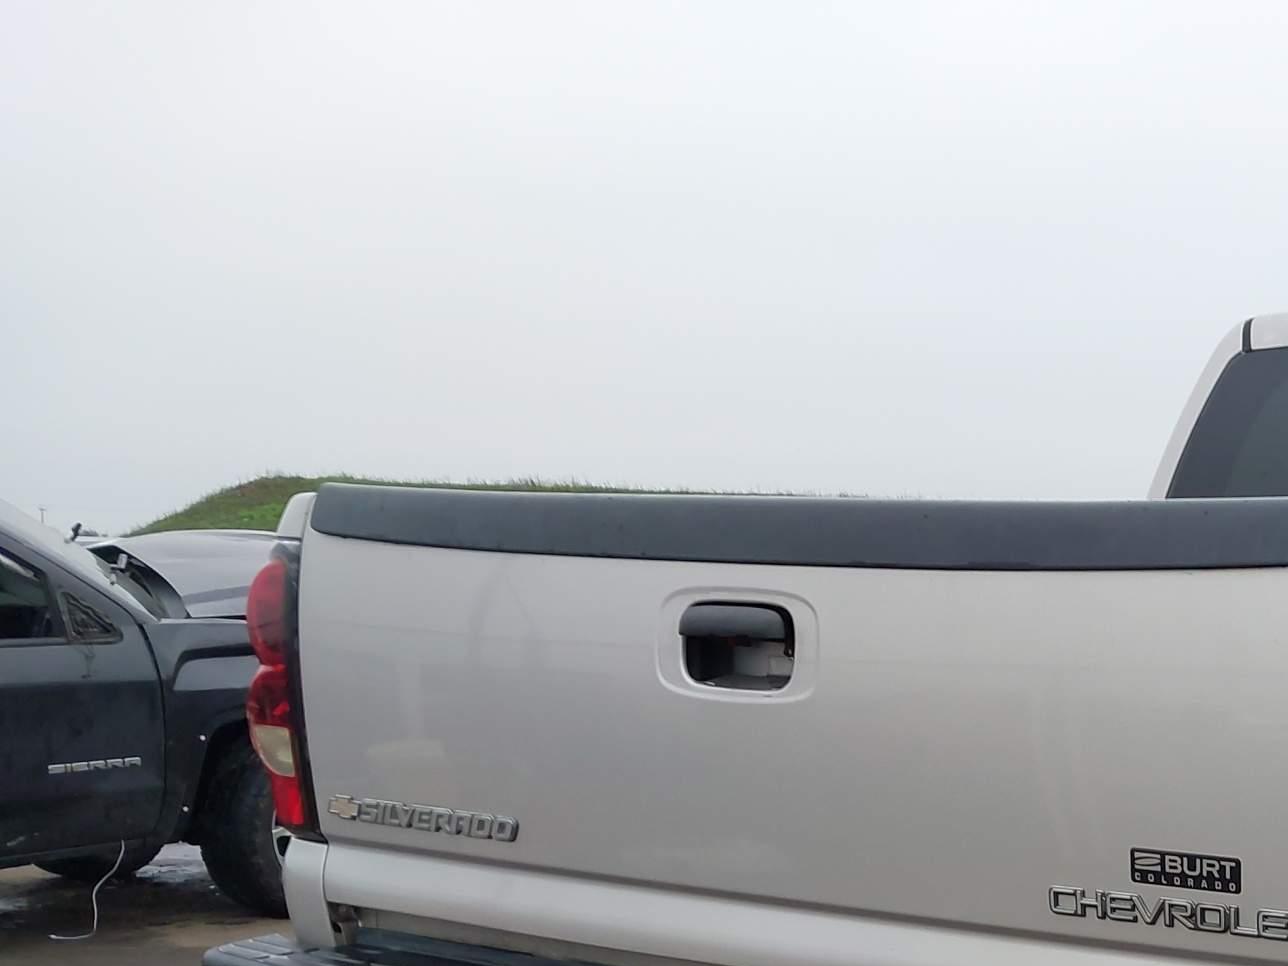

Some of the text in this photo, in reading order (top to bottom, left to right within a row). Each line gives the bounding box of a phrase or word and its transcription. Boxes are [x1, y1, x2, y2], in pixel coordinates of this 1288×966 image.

[47, 756, 142, 774] SIERRA
[359, 798, 519, 842] SILVERADO
[1165, 854, 1237, 880] BURT
[1134, 871, 1237, 892] COLORADO
